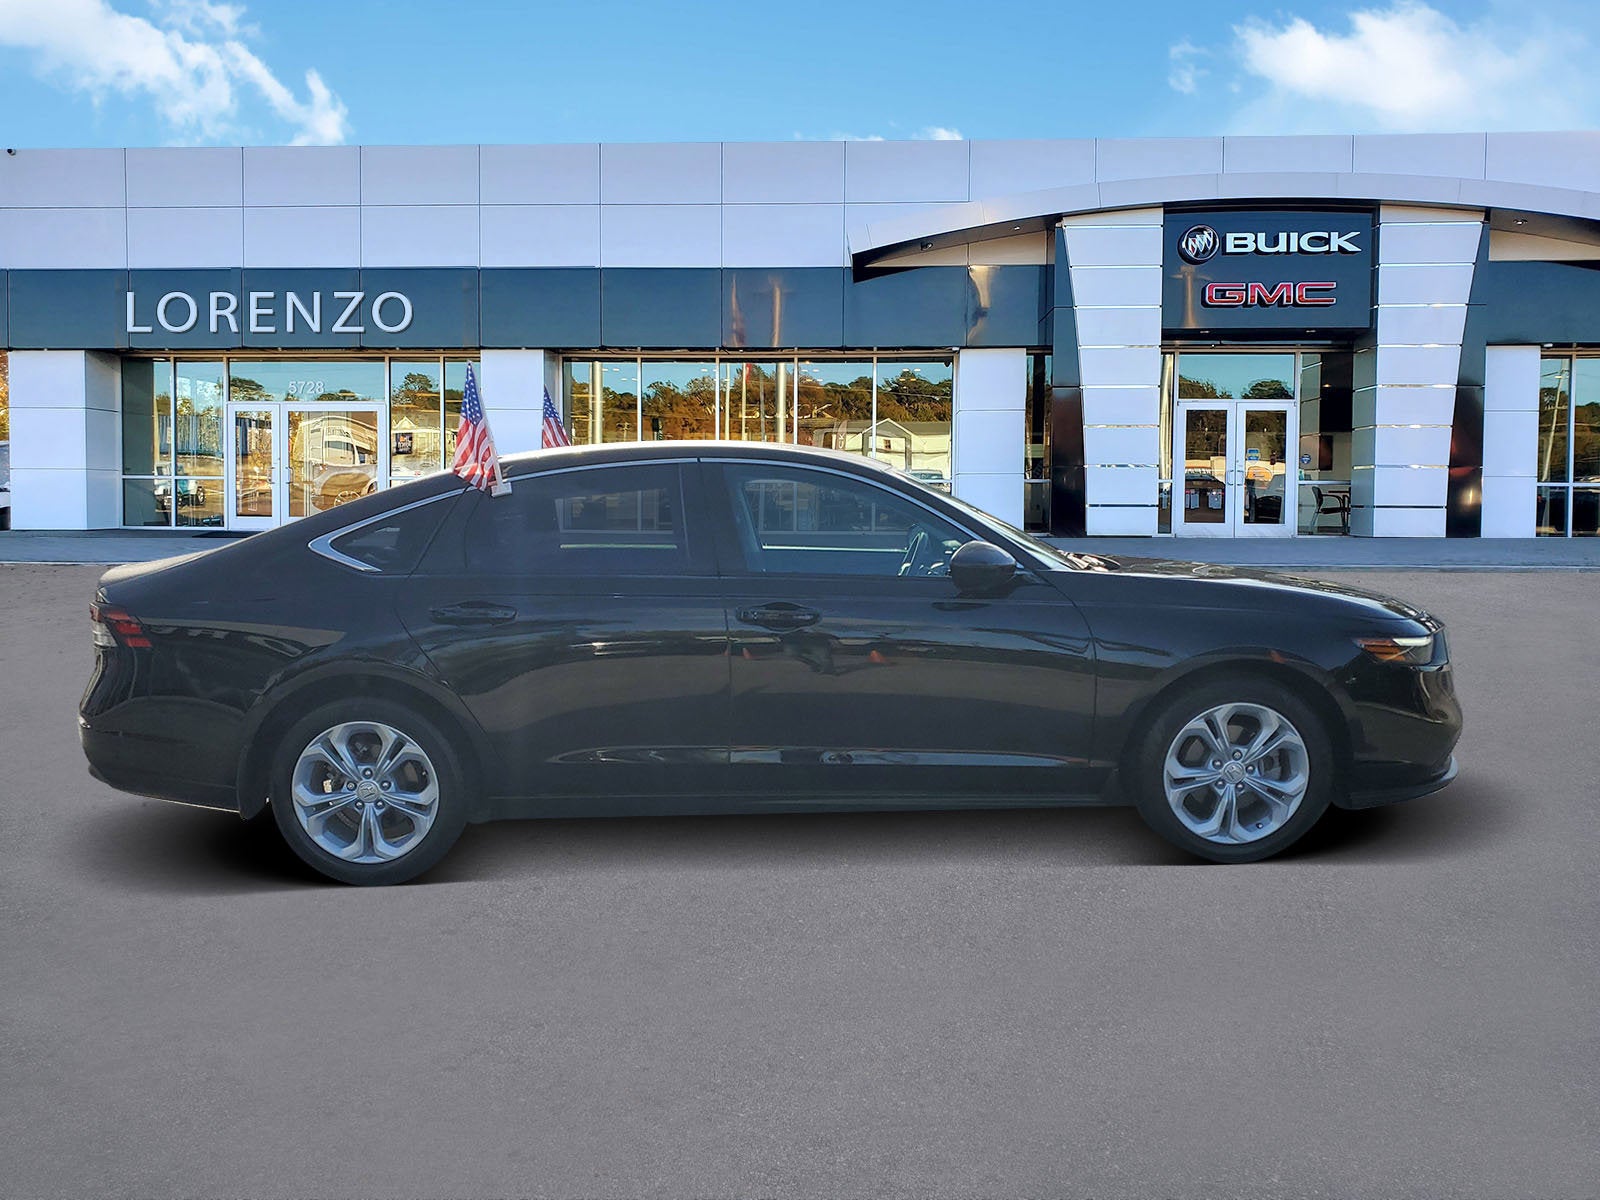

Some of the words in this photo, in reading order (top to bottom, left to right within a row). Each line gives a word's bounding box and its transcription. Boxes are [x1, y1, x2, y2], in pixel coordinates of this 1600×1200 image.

[1225, 231, 1362, 253] BUICK
[1205, 281, 1337, 306] GMC
[126, 290, 414, 334] LORENZO
[287, 380, 325, 395] 5728
